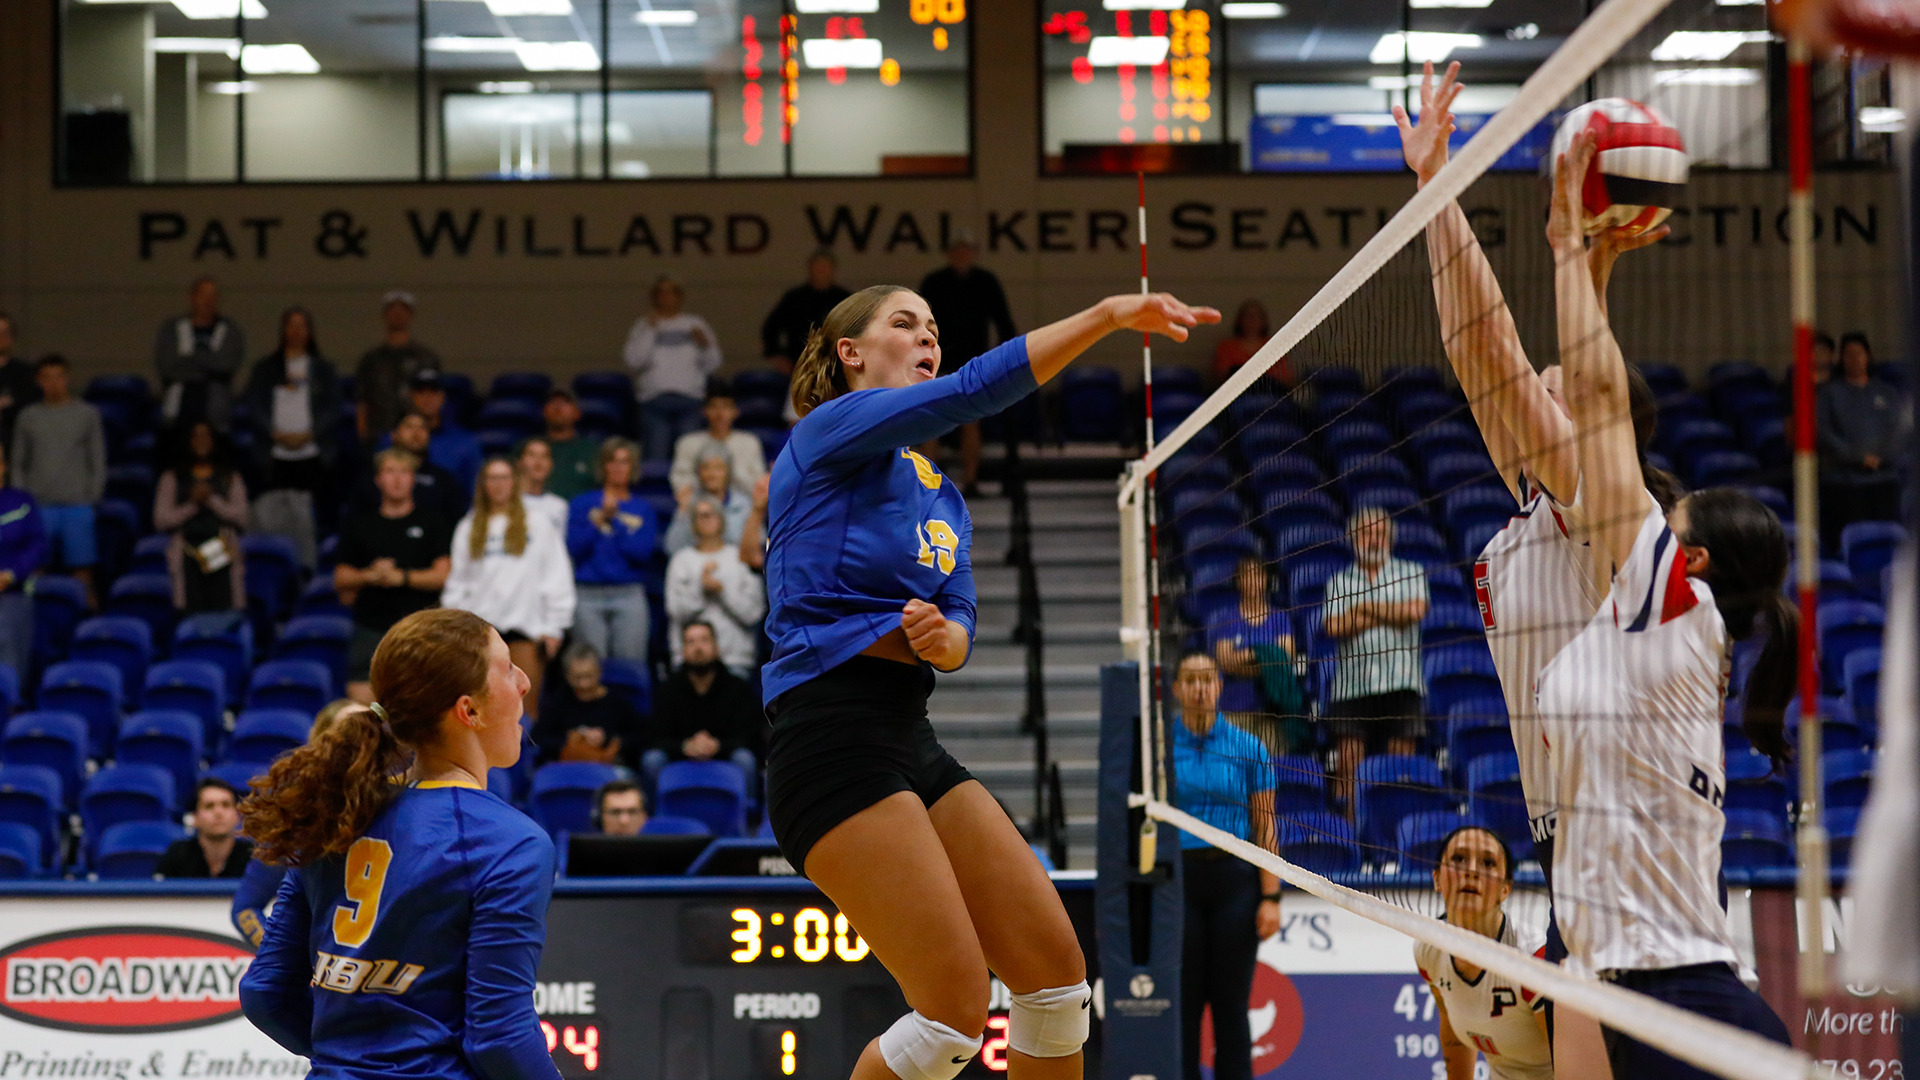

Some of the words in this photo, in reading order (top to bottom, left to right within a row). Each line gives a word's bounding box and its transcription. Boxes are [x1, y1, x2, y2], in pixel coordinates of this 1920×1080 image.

[138, 212, 284, 261] PAT
[313, 209, 371, 259] &
[406, 208, 771, 258] WILLARD
[916, 519, 960, 577] 19
[332, 836, 394, 949] 9
[731, 908, 871, 963] 3:00
[11, 961, 247, 997] BROADWAY
[533, 982, 596, 1015] OME
[734, 993, 822, 1020] PERIOD
[1490, 987, 1518, 1017] P
[1804, 1006, 1874, 1035] More
[0, 1051, 132, 1080] Printing
[141, 1052, 164, 1078] &
[781, 1030, 796, 1075] 1
